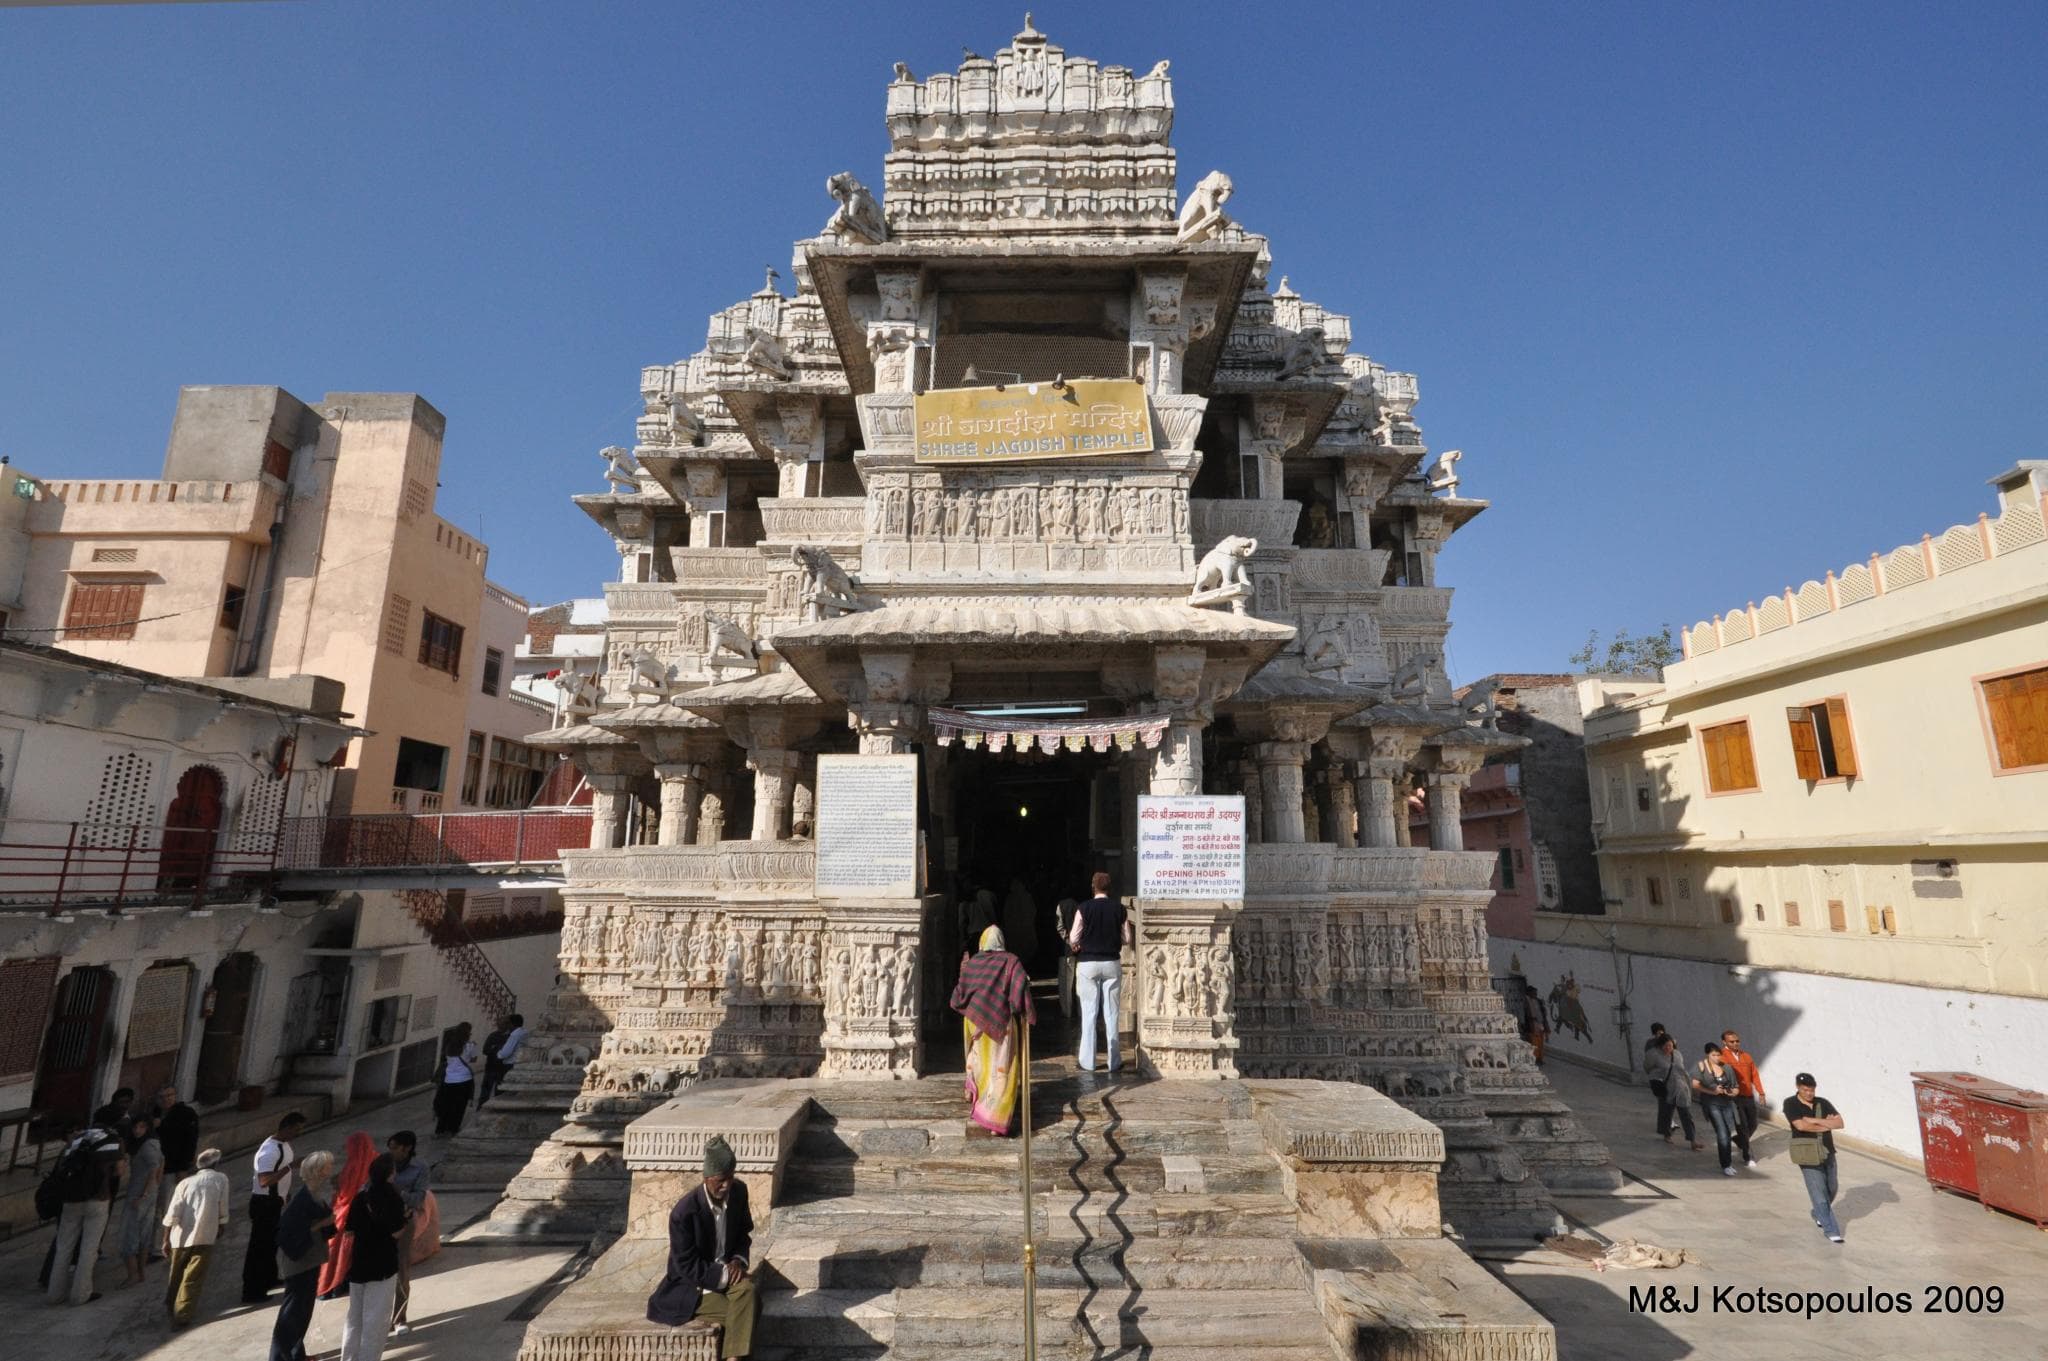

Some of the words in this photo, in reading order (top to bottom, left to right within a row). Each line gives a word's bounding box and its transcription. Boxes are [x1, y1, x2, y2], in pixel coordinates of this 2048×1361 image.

[921, 412, 953, 438] श्री
[918, 441, 979, 458] SHREE
[984, 434, 1066, 456] JAGDISH
[1069, 430, 1146, 450] TEMPLE
[1156, 870, 1193, 878] OPENING
[1196, 870, 1226, 878] HOURS
